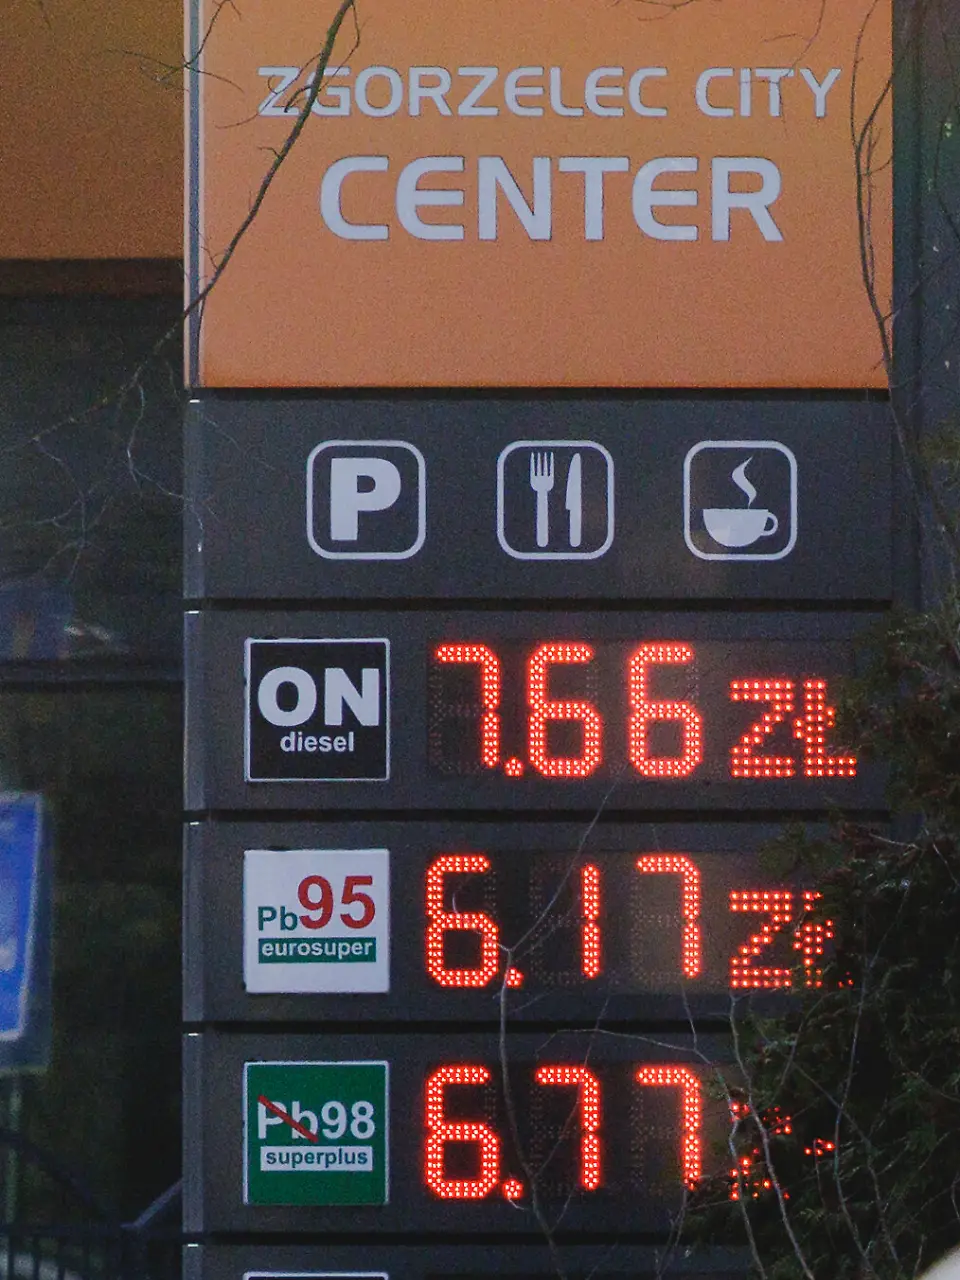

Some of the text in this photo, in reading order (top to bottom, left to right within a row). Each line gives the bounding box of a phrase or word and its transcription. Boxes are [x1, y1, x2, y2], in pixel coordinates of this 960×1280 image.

[257, 66, 842, 119] ZGORZELEC CITY
[319, 155, 784, 243] CENTER
[330, 456, 402, 542] P
[257, 666, 381, 727] ON
[436, 643, 702, 778] 7.66
[279, 731, 356, 753] diesel
[256, 874, 377, 932] Pb95
[424, 855, 701, 989] 6.17
[260, 937, 374, 962] eurosuper
[264, 1147, 370, 1169] superplus
[424, 1065, 701, 1199] 6.77
